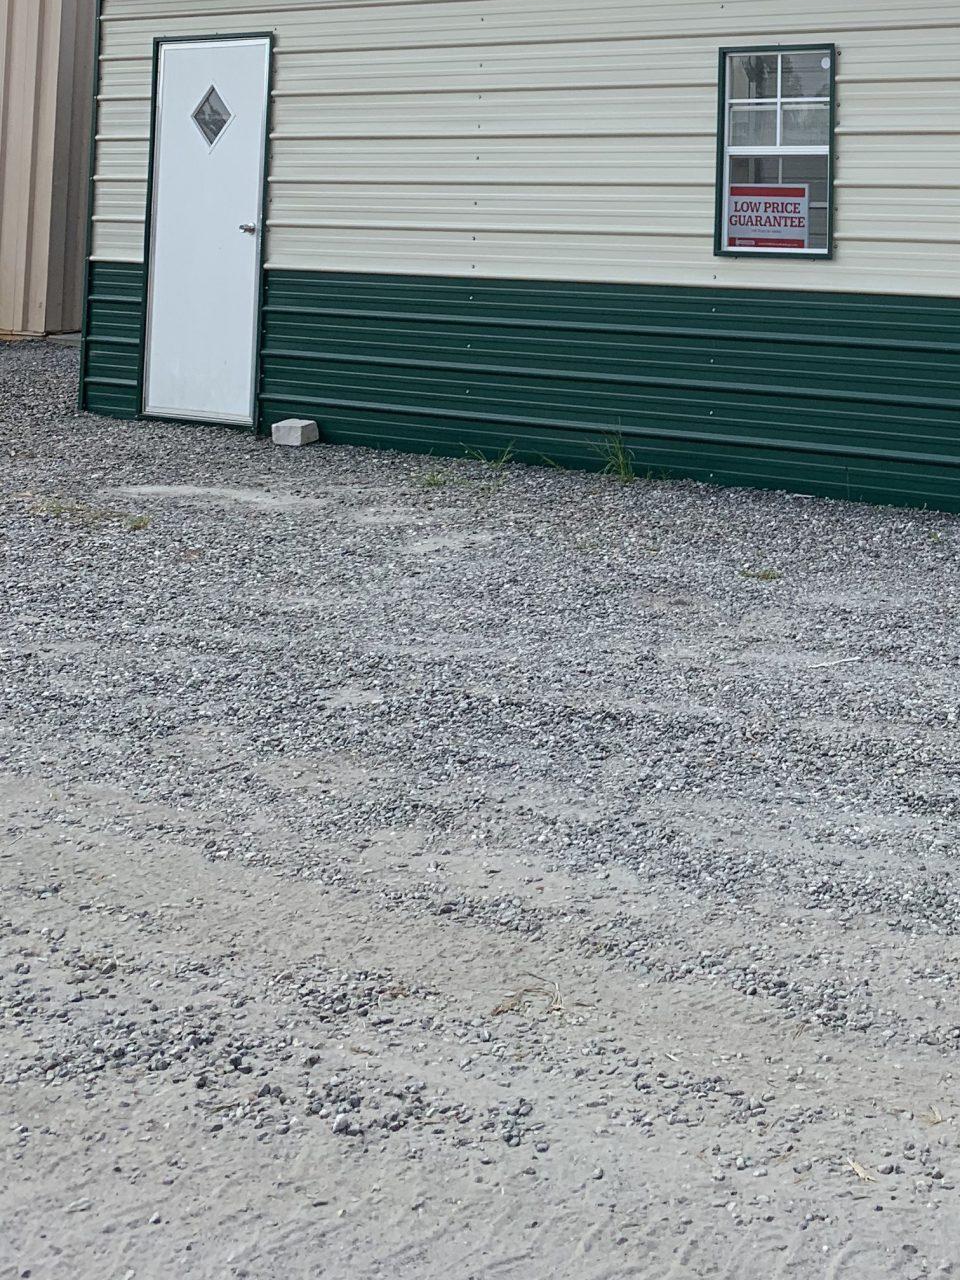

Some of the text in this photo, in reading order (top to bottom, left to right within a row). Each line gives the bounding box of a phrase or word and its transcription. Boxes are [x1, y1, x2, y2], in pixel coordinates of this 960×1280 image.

[734, 201, 801, 214] LOW PRICE
[729, 215, 805, 228] GUARANTEE
